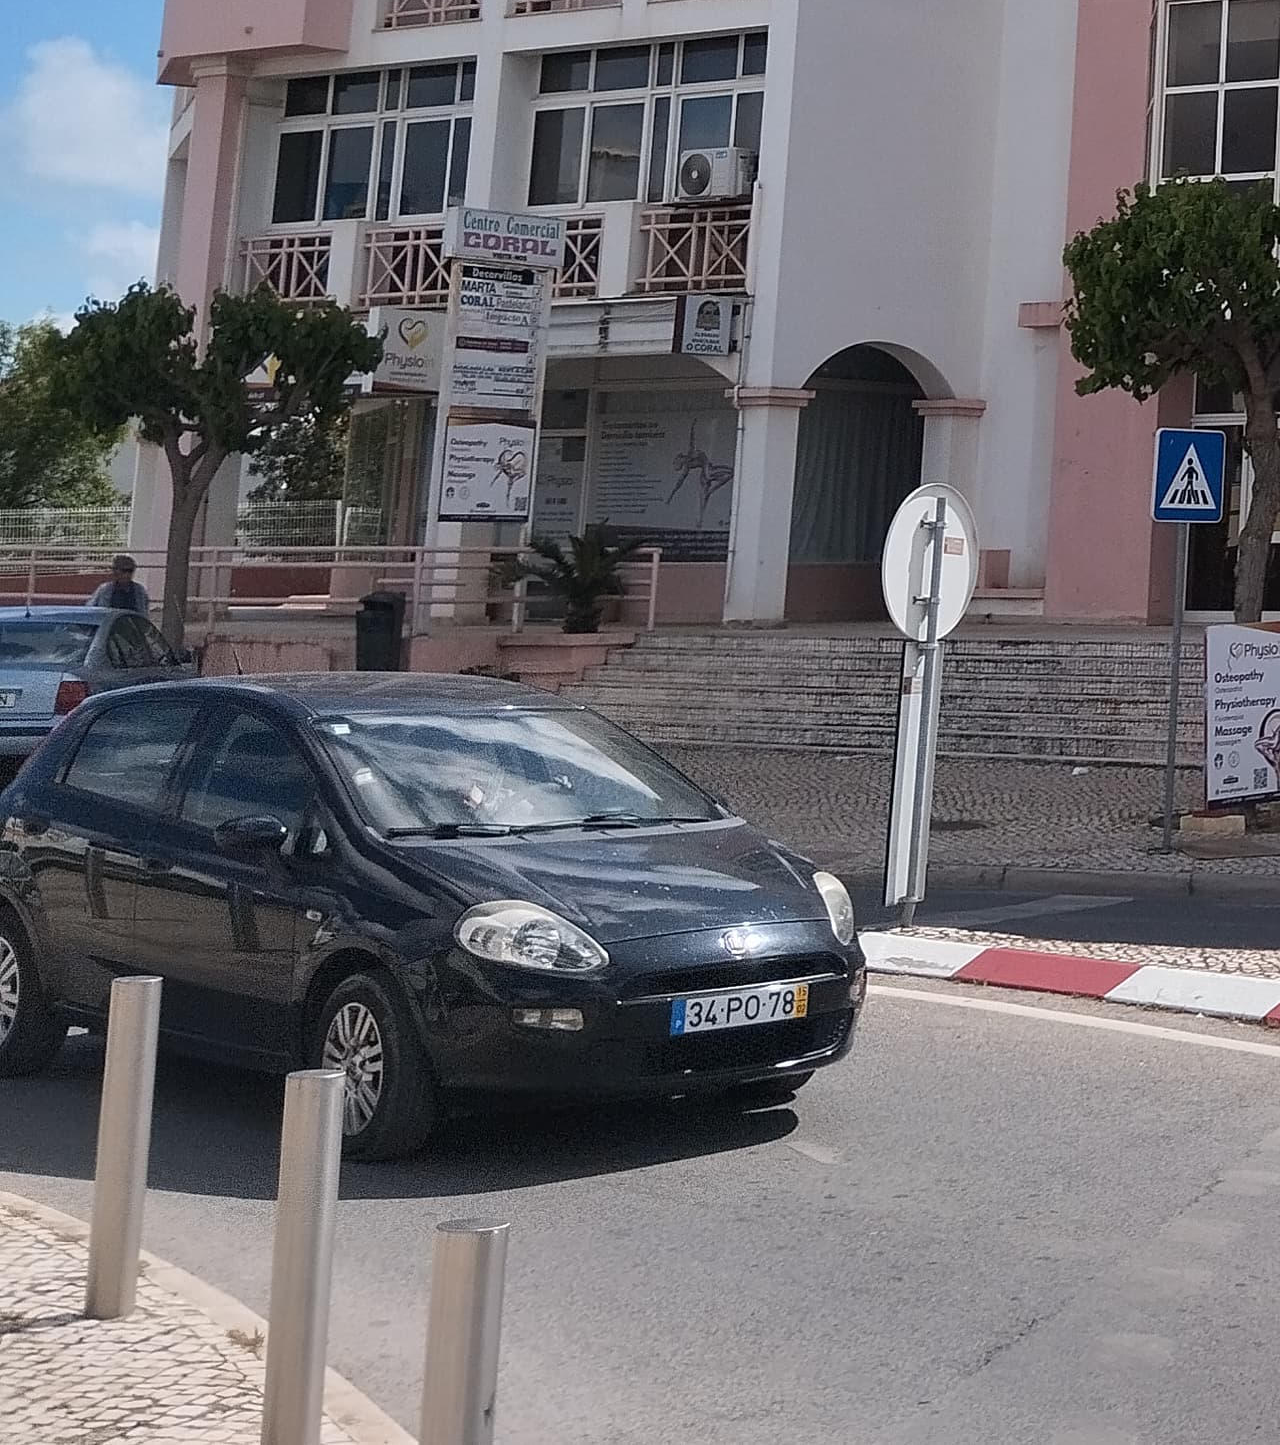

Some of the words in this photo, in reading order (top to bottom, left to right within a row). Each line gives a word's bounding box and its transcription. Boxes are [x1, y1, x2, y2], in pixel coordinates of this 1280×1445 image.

[464, 211, 500, 232] Centro
[507, 216, 560, 239] Comercial
[464, 232, 557, 256] CORAL
[462, 280, 497, 293] MARTA
[461, 295, 494, 307] CORAL
[687, 343, 693, 351] O
[695, 344, 723, 353] CORAL
[1214, 669, 1264, 684] Osteopathy
[1214, 696, 1277, 712] Physiotherapy
[1214, 726, 1252, 737] Massage
